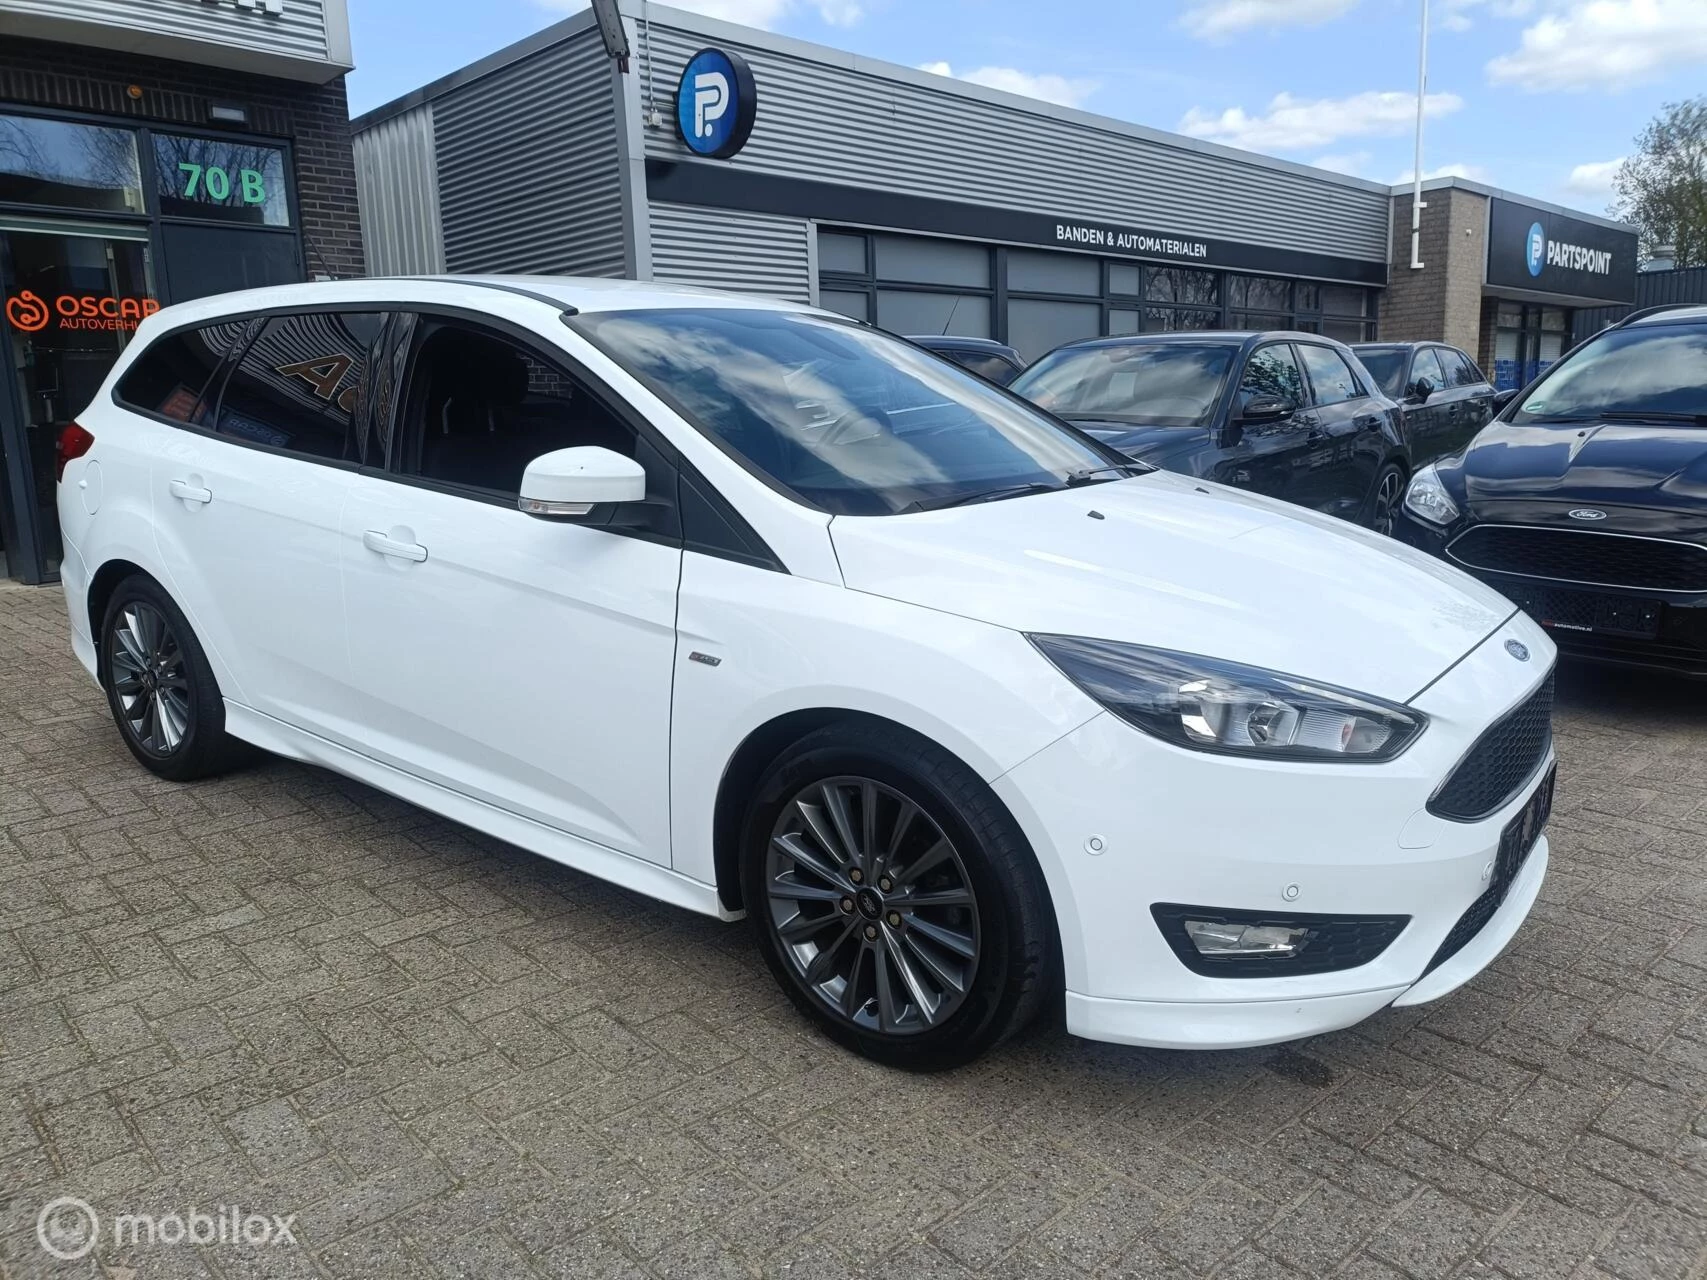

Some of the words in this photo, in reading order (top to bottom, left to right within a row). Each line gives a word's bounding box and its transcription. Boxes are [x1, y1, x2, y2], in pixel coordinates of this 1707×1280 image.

[178, 162, 230, 200] 70
[240, 169, 266, 204] B
[1056, 224, 1104, 245] BANDEN
[1106, 231, 1114, 246] &
[1117, 233, 1207, 257] AUTOMATERIALEN
[1547, 240, 1612, 275] PARTSPOINT
